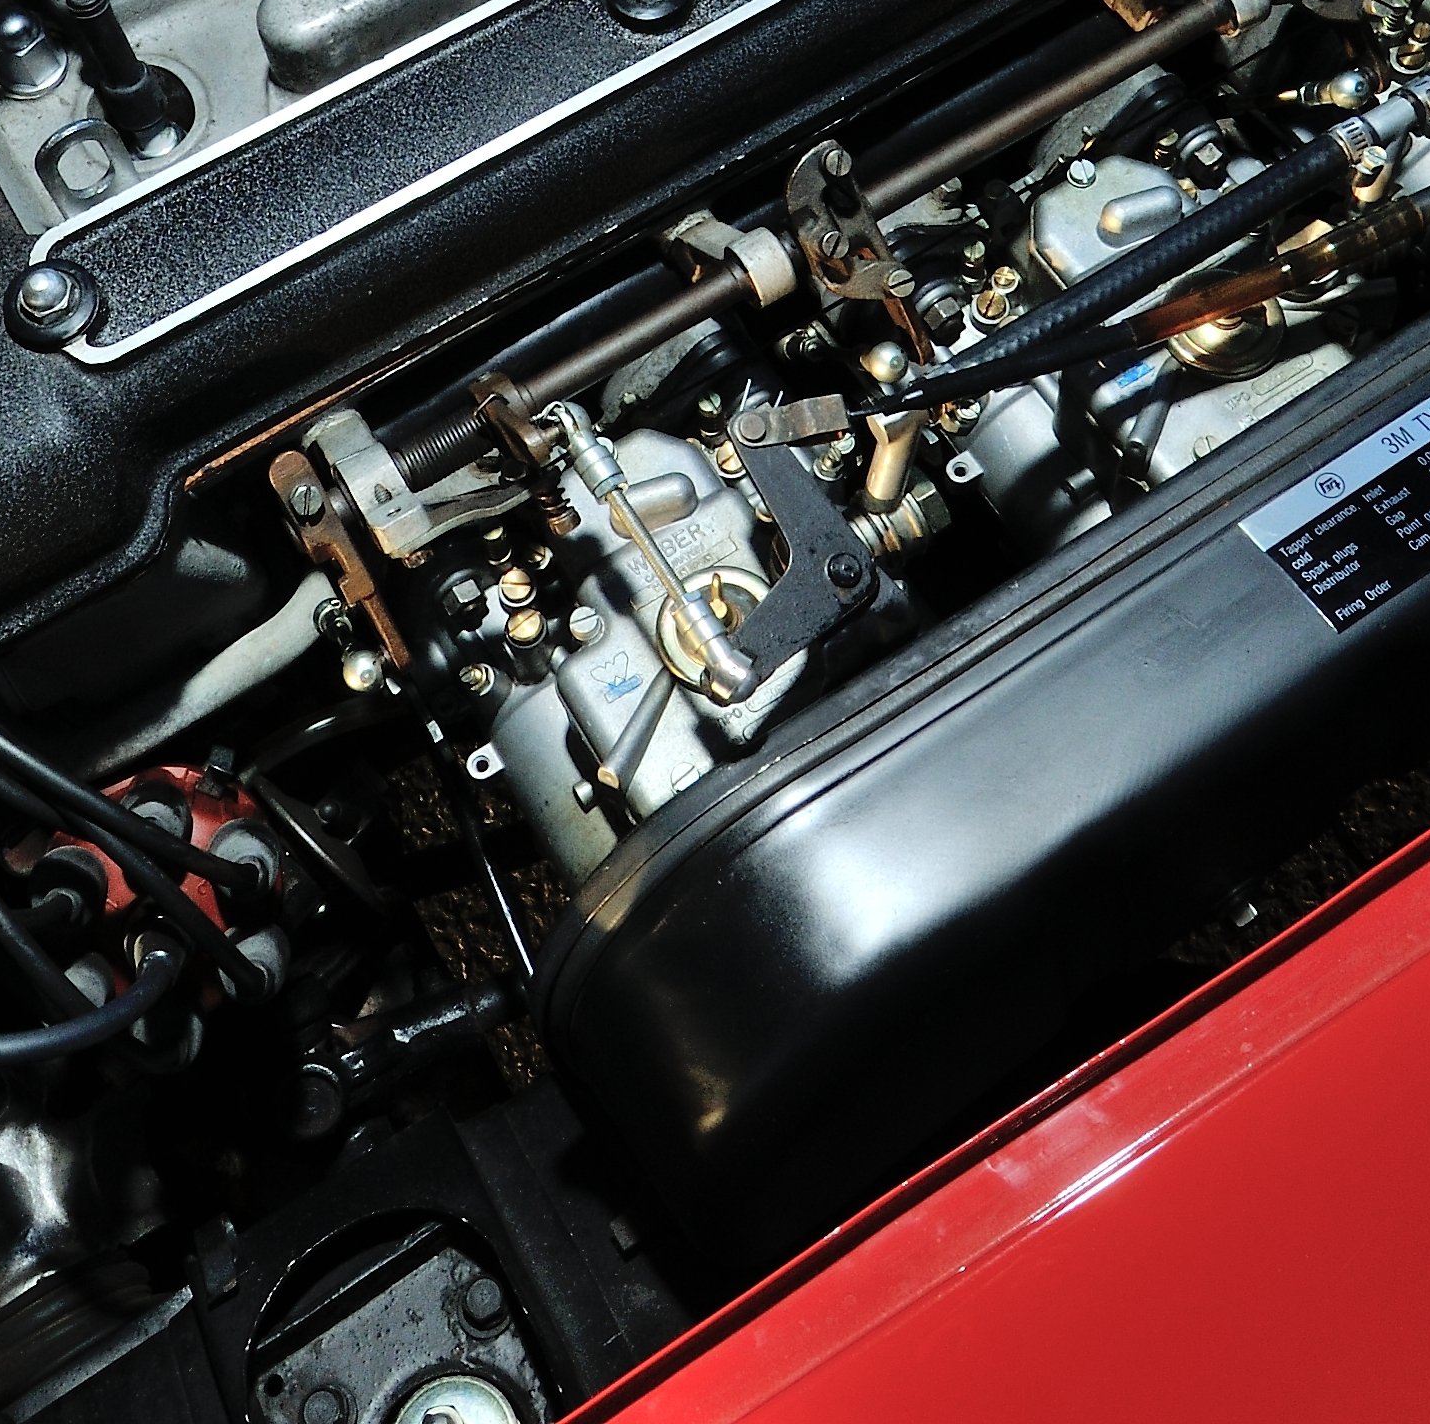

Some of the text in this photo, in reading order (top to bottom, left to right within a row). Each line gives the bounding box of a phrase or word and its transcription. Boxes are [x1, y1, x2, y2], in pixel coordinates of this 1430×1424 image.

[1381, 426, 1414, 453] 3M
[1278, 533, 1312, 556] Tappet
[1361, 485, 1385, 502] Inlet
[1292, 551, 1312, 569] cold
[1373, 487, 1410, 513] Exhaust
[1301, 560, 1331, 581] Spark
[1332, 542, 1358, 563] plugs
[1385, 510, 1405, 525] Gap
[1312, 560, 1360, 594] Distributor
[1396, 518, 1422, 537] Point
[1408, 533, 1430, 550] Cam
[1335, 599, 1365, 620] Firing
[1364, 580, 1390, 600] Order
